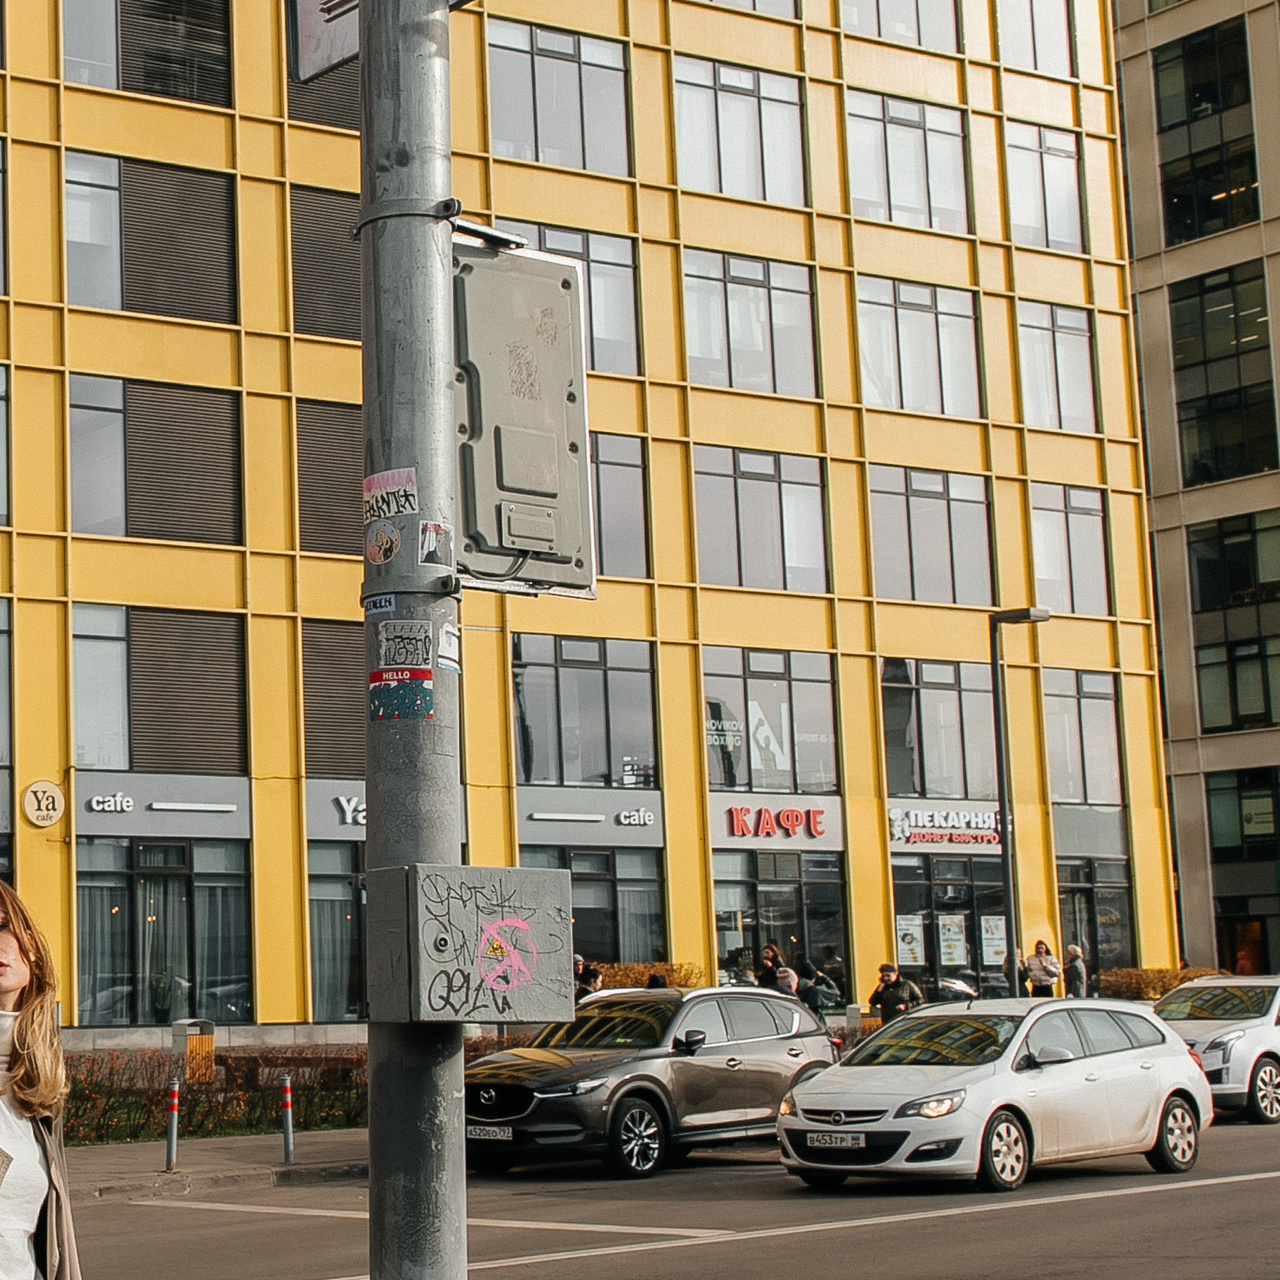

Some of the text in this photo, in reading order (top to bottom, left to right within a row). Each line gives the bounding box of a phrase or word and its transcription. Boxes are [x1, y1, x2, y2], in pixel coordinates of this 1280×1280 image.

[382, 671, 410, 680] HELLO
[30, 790, 57, 812] Ya
[91, 792, 134, 812] cafe
[36, 813, 54, 822] cafe
[619, 807, 655, 825] cafe
[731, 806, 826, 838] КАФЕ
[909, 810, 996, 829] ПЕКАРНЯ
[909, 831, 950, 843] ДОНЕР
